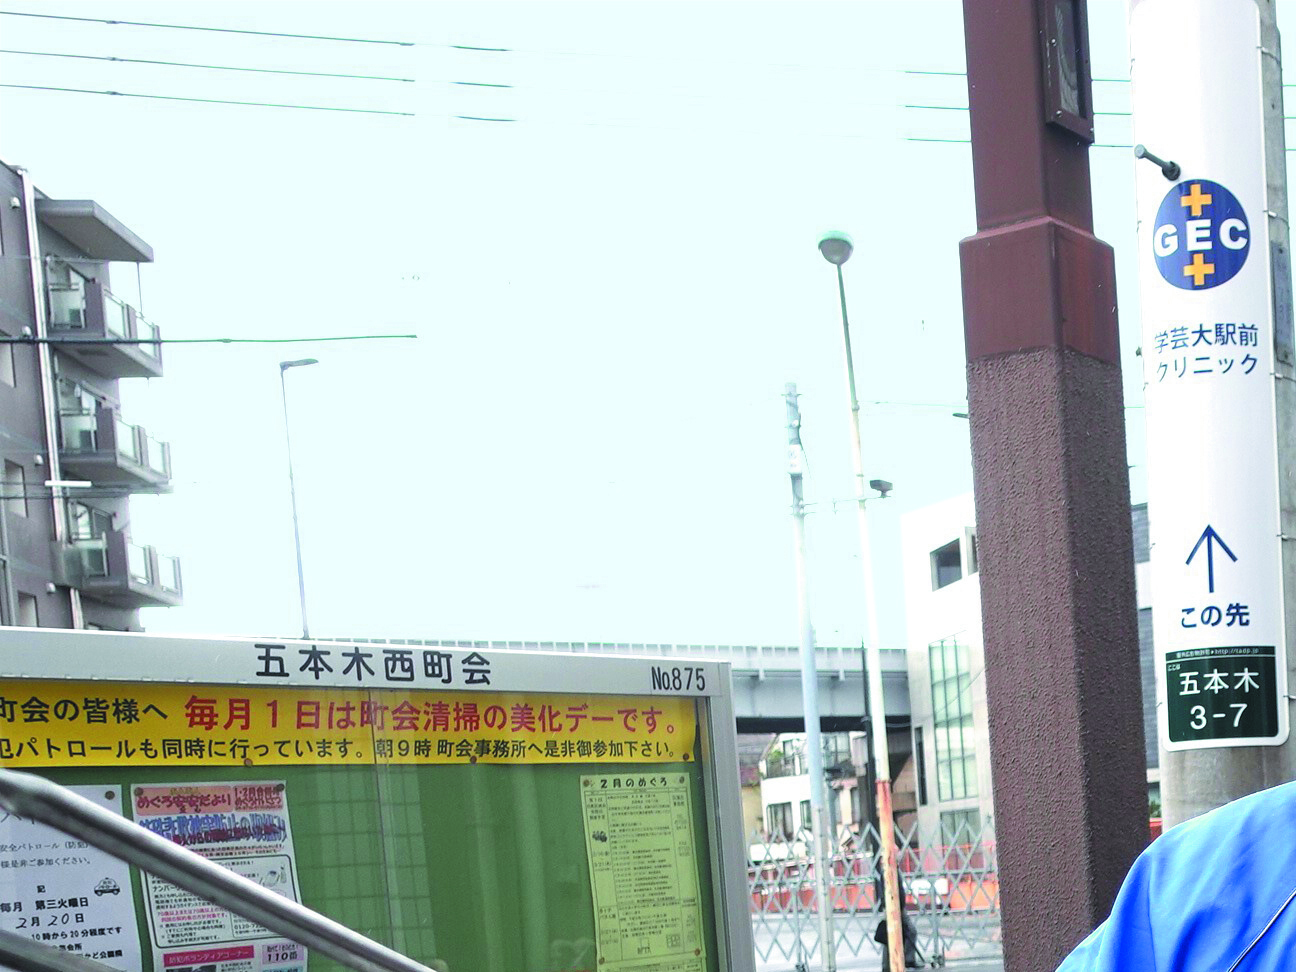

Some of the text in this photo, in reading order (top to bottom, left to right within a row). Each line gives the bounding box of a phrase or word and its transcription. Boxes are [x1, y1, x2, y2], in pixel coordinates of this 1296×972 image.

[1154, 218, 1248, 258] GEC
[1154, 323, 1259, 354] 学芸大駅前
[1156, 354, 1258, 382] クリニック
[1181, 602, 1250, 628] この先
[255, 643, 491, 687] 五本木西町会
[1179, 667, 1260, 696] 五本木
[1190, 703, 1248, 730] 3-7
